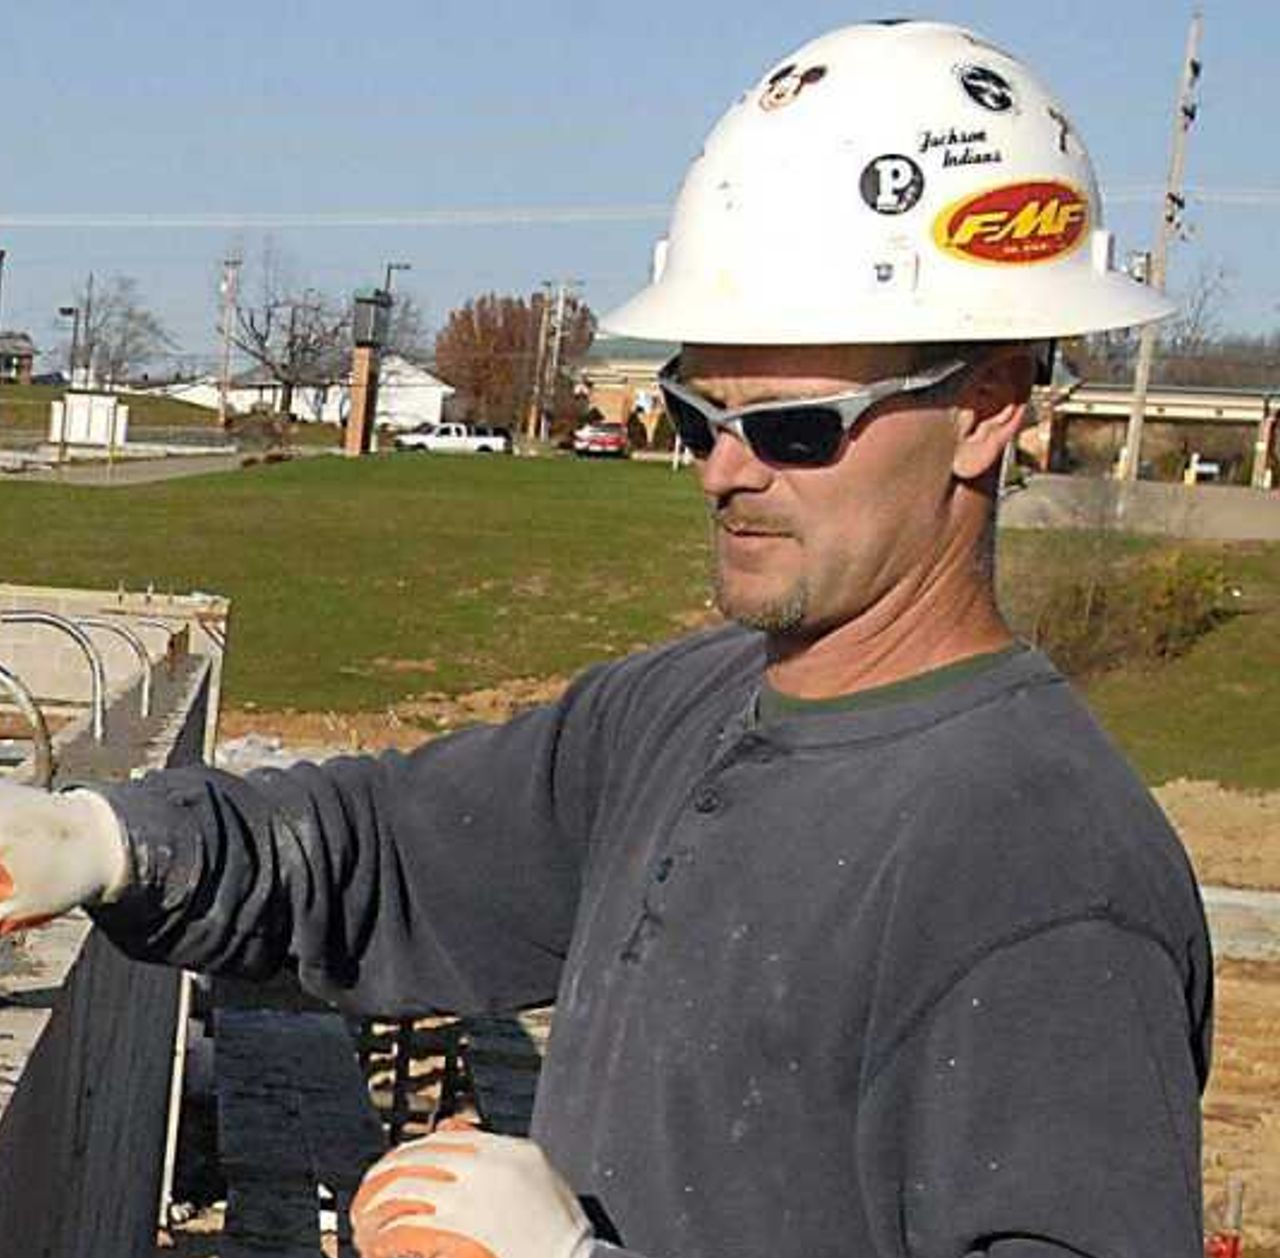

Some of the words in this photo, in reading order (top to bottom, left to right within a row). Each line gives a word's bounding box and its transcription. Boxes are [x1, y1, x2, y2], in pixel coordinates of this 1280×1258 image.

[920, 128, 987, 151] Jackson
[942, 149, 1003, 168] Indians
[953, 199, 1087, 244] FMF
